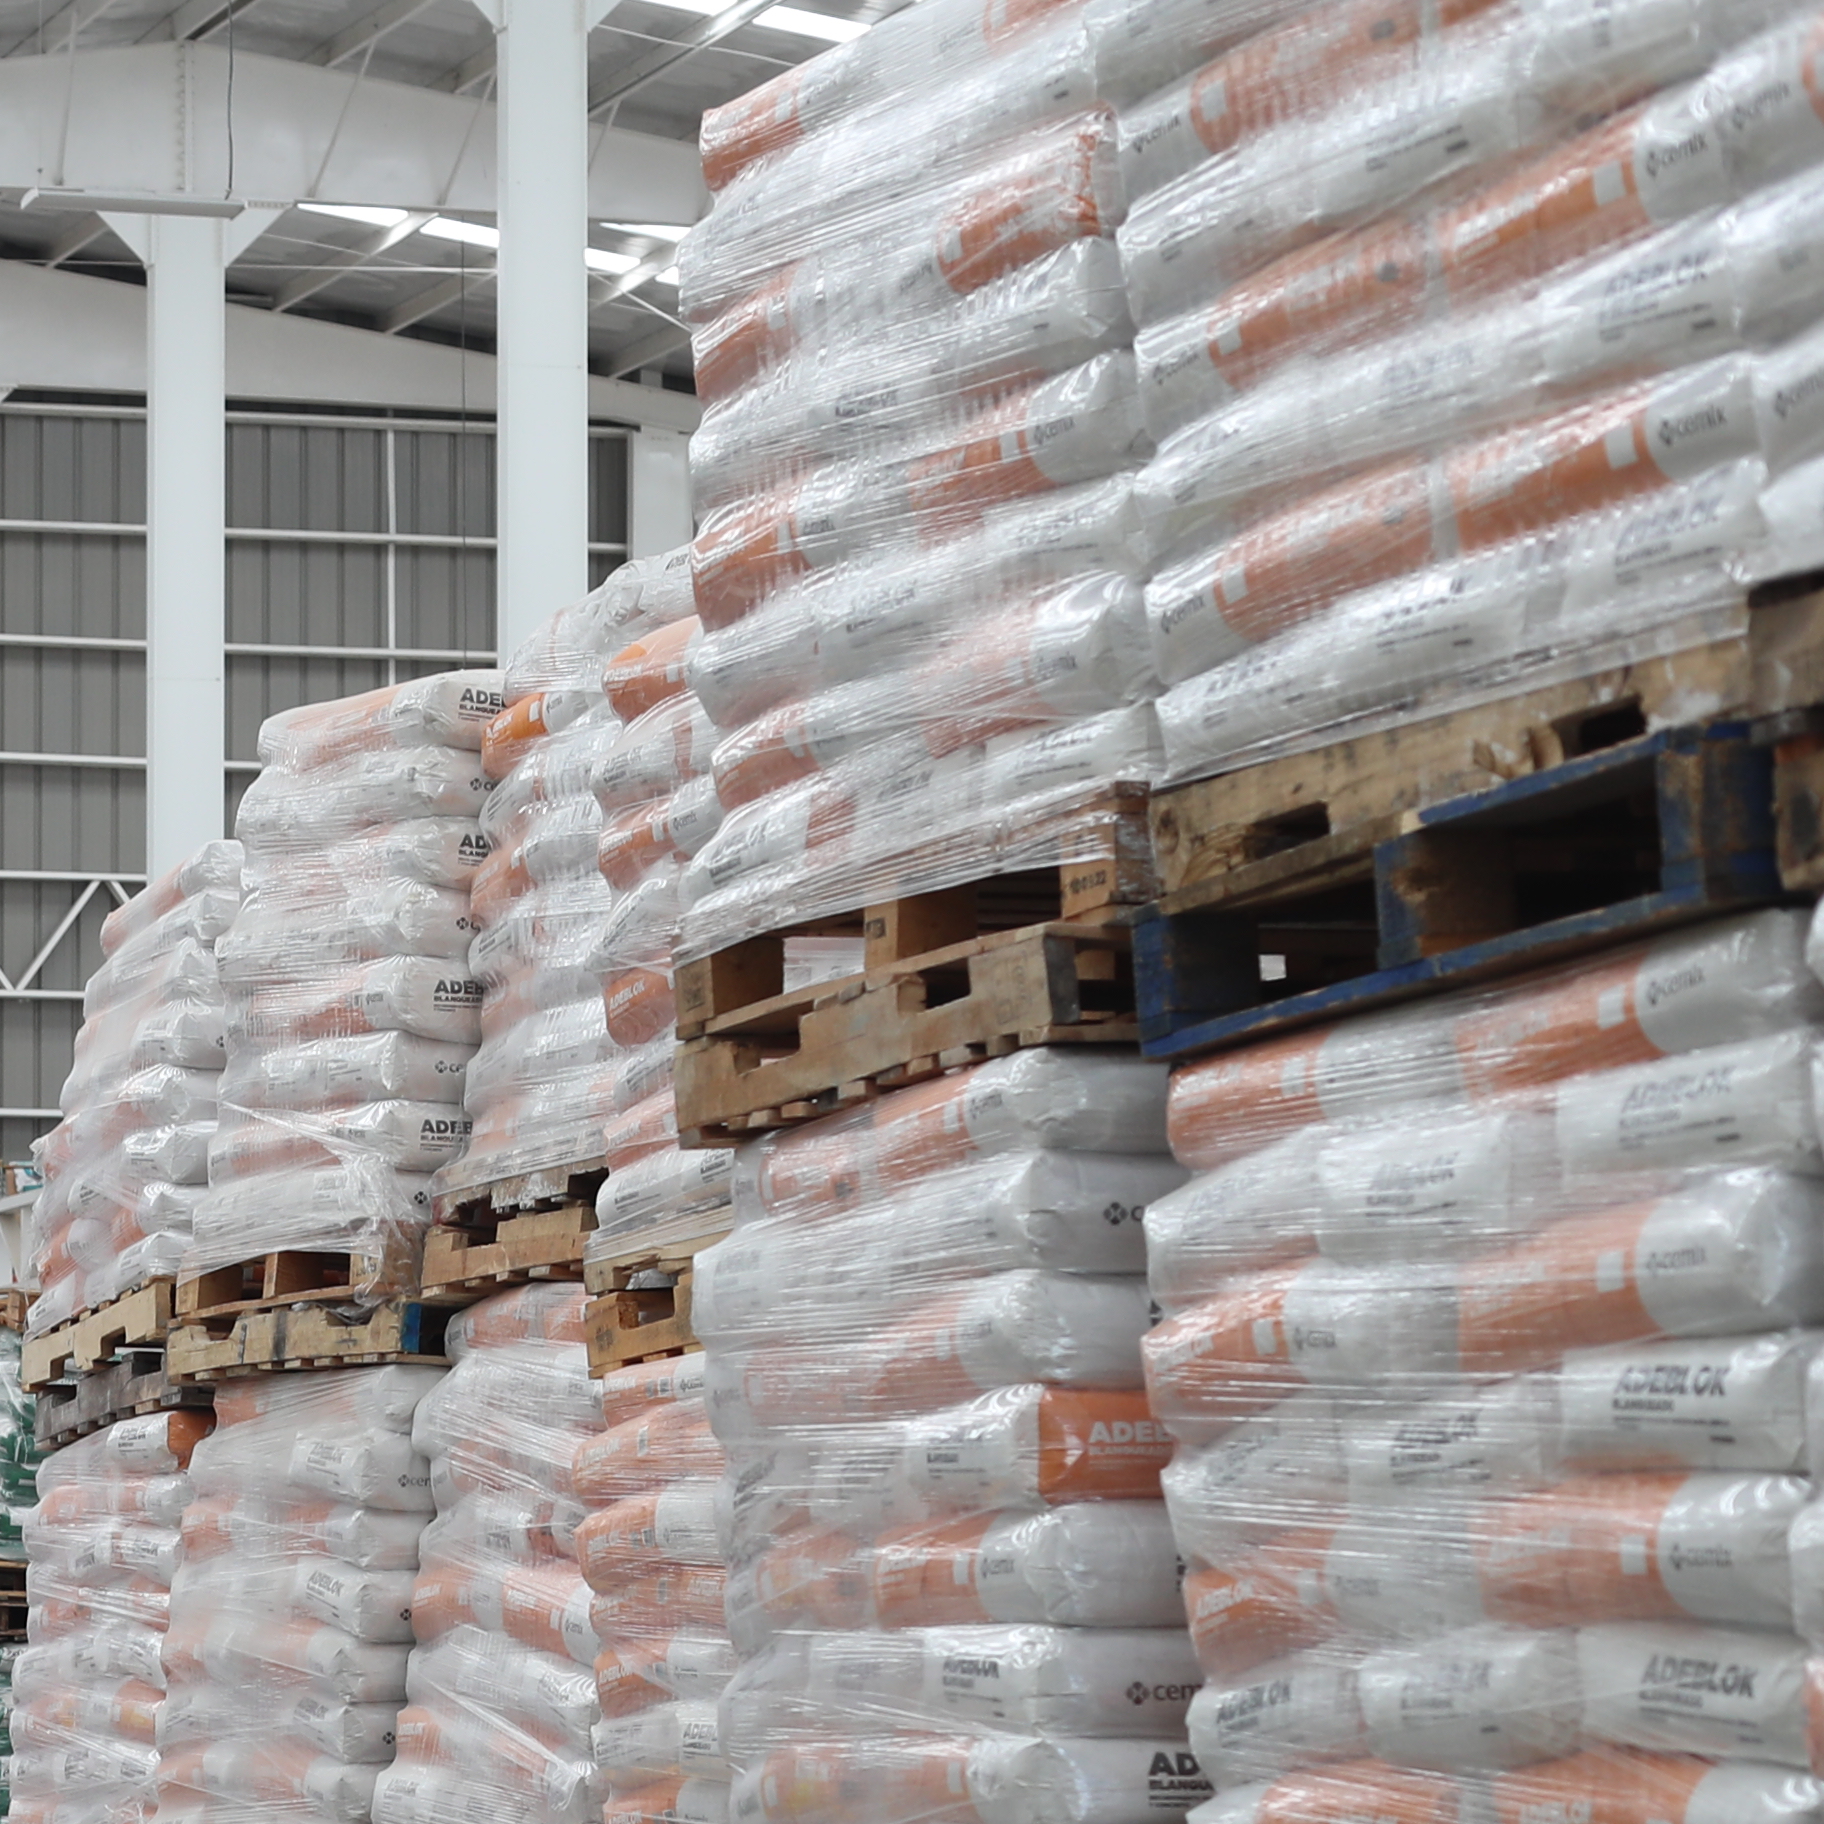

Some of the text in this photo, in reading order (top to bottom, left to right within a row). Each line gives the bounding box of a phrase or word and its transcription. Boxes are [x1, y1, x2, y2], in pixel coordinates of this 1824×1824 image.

[1614, 1365, 1729, 1395] ADEBLOK
[308, 1570, 344, 1598] ADEBLOK
[1642, 1655, 1761, 1697] ADEBLOK
